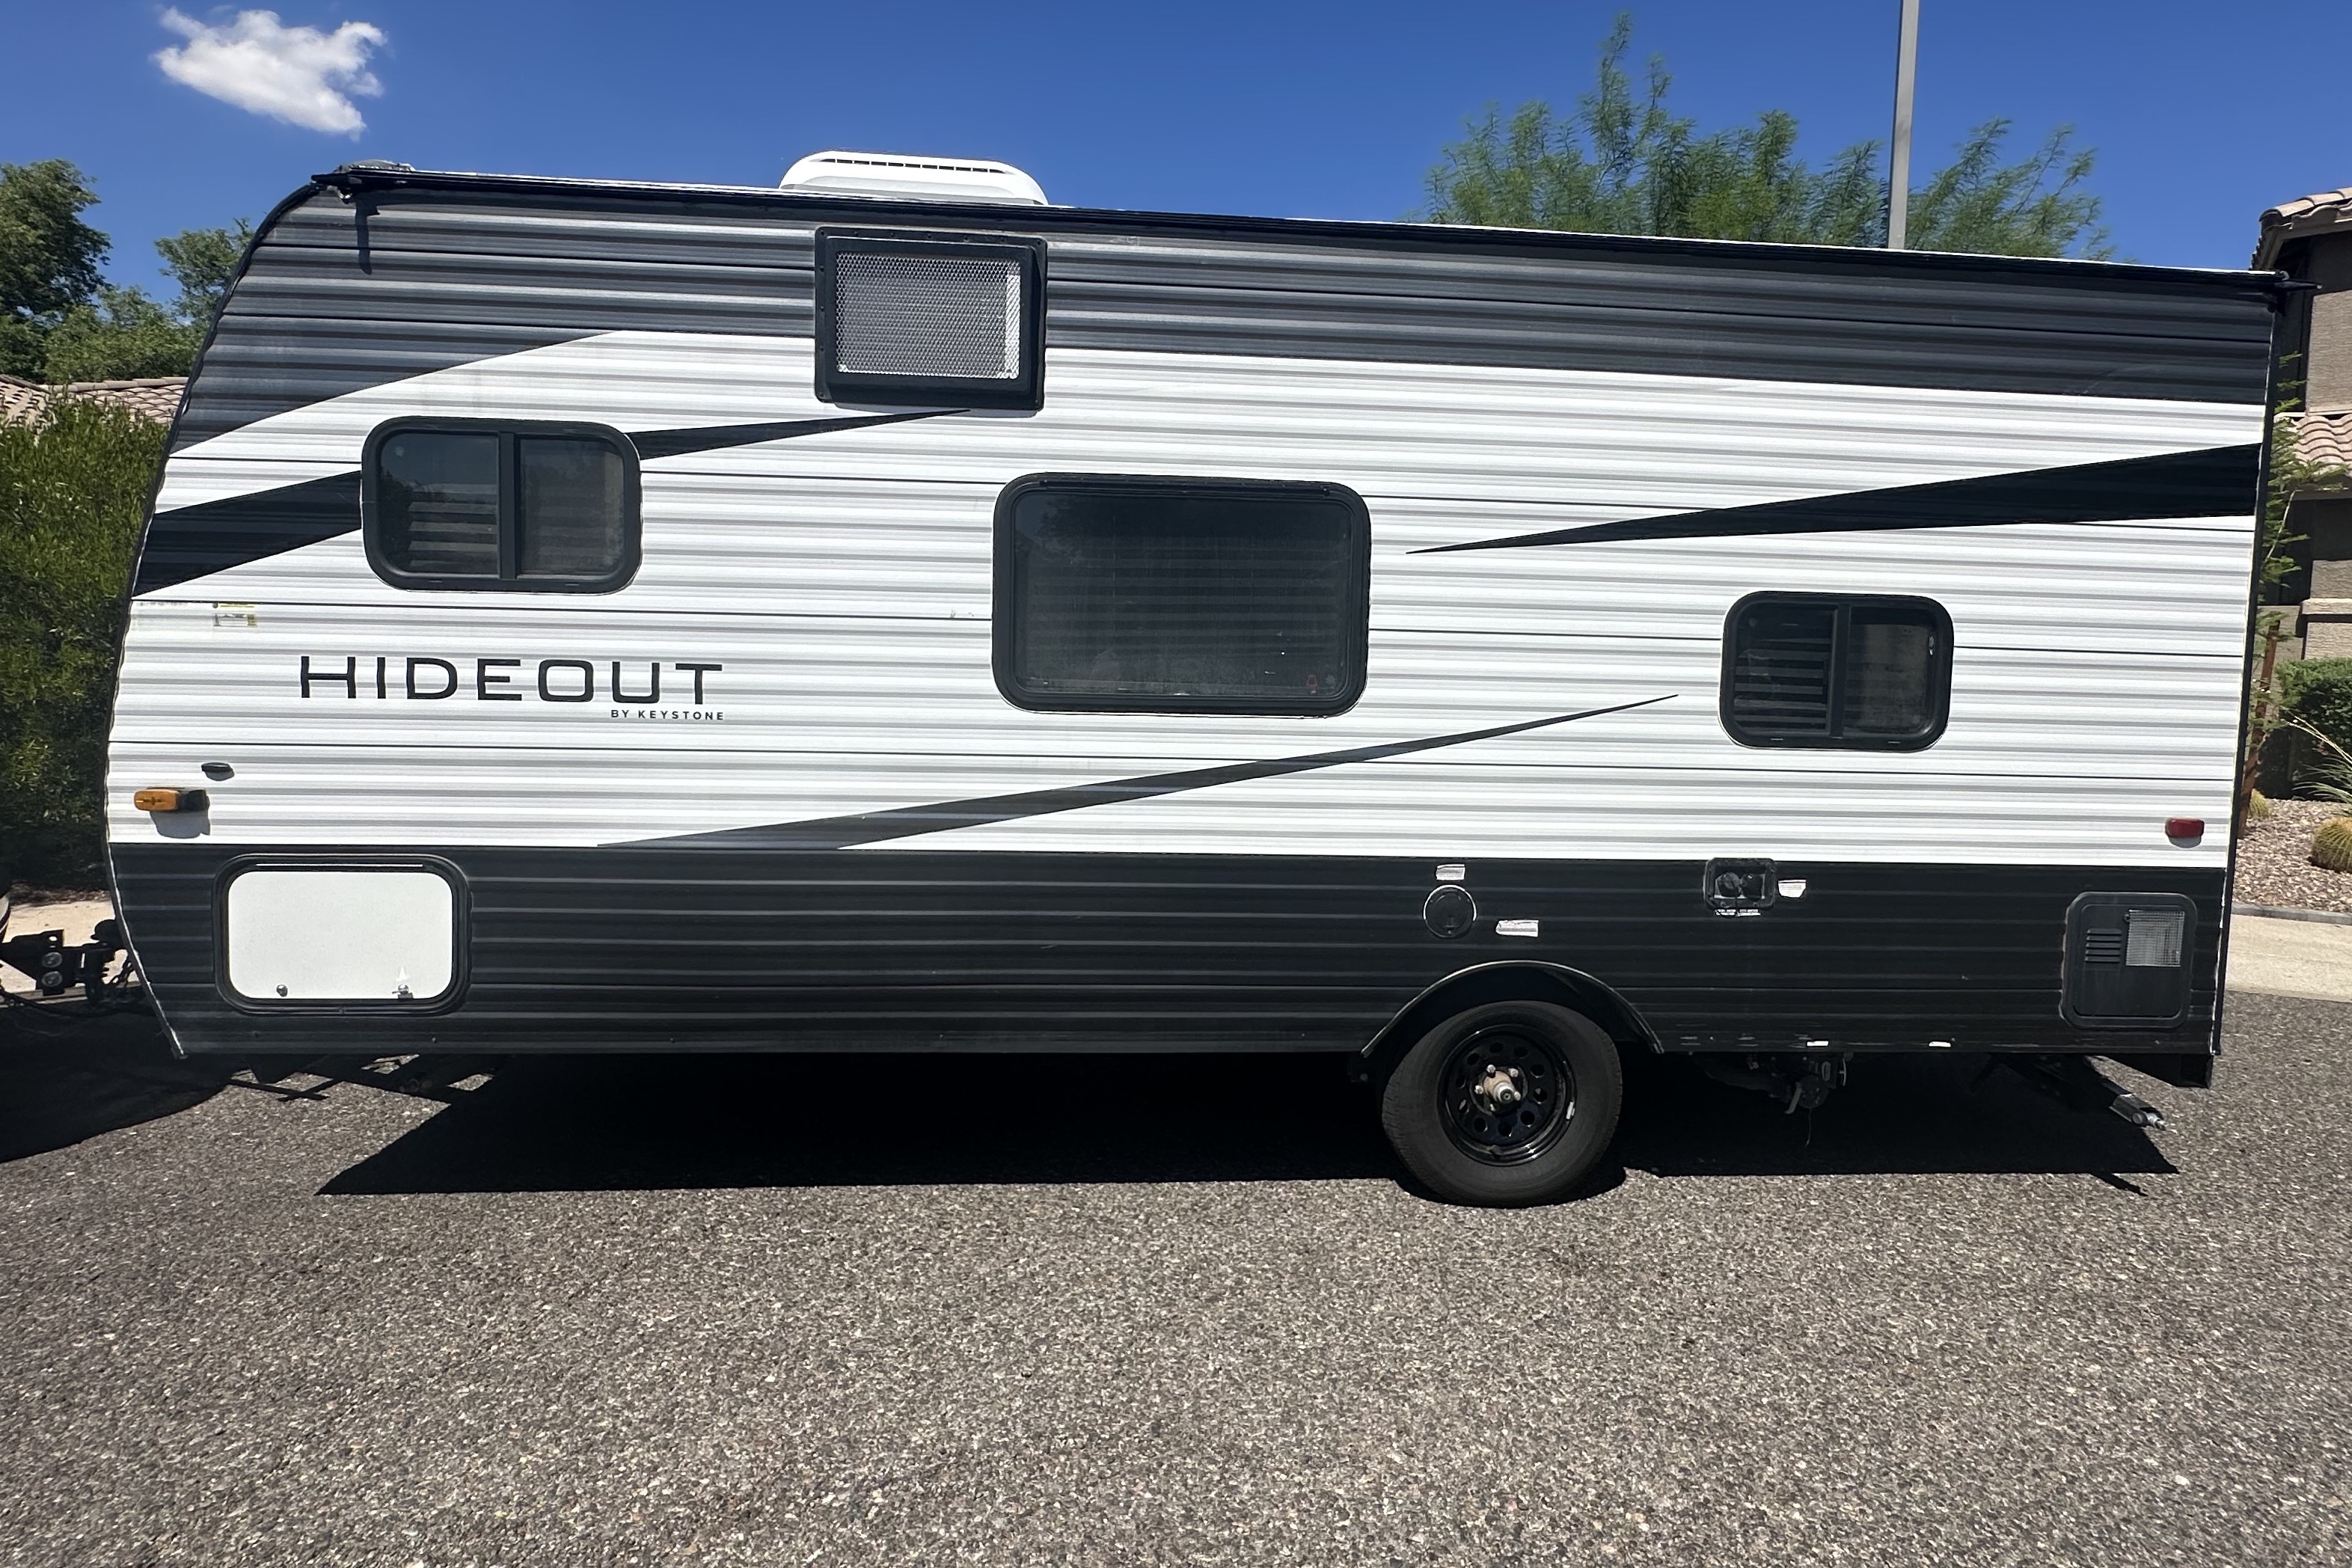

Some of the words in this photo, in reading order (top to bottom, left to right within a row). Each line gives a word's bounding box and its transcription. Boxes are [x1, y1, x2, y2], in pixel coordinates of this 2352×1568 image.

[301, 656, 723, 705] HIDEOUT
[611, 709, 630, 718] BY
[638, 710, 724, 720] KEYSTONE
